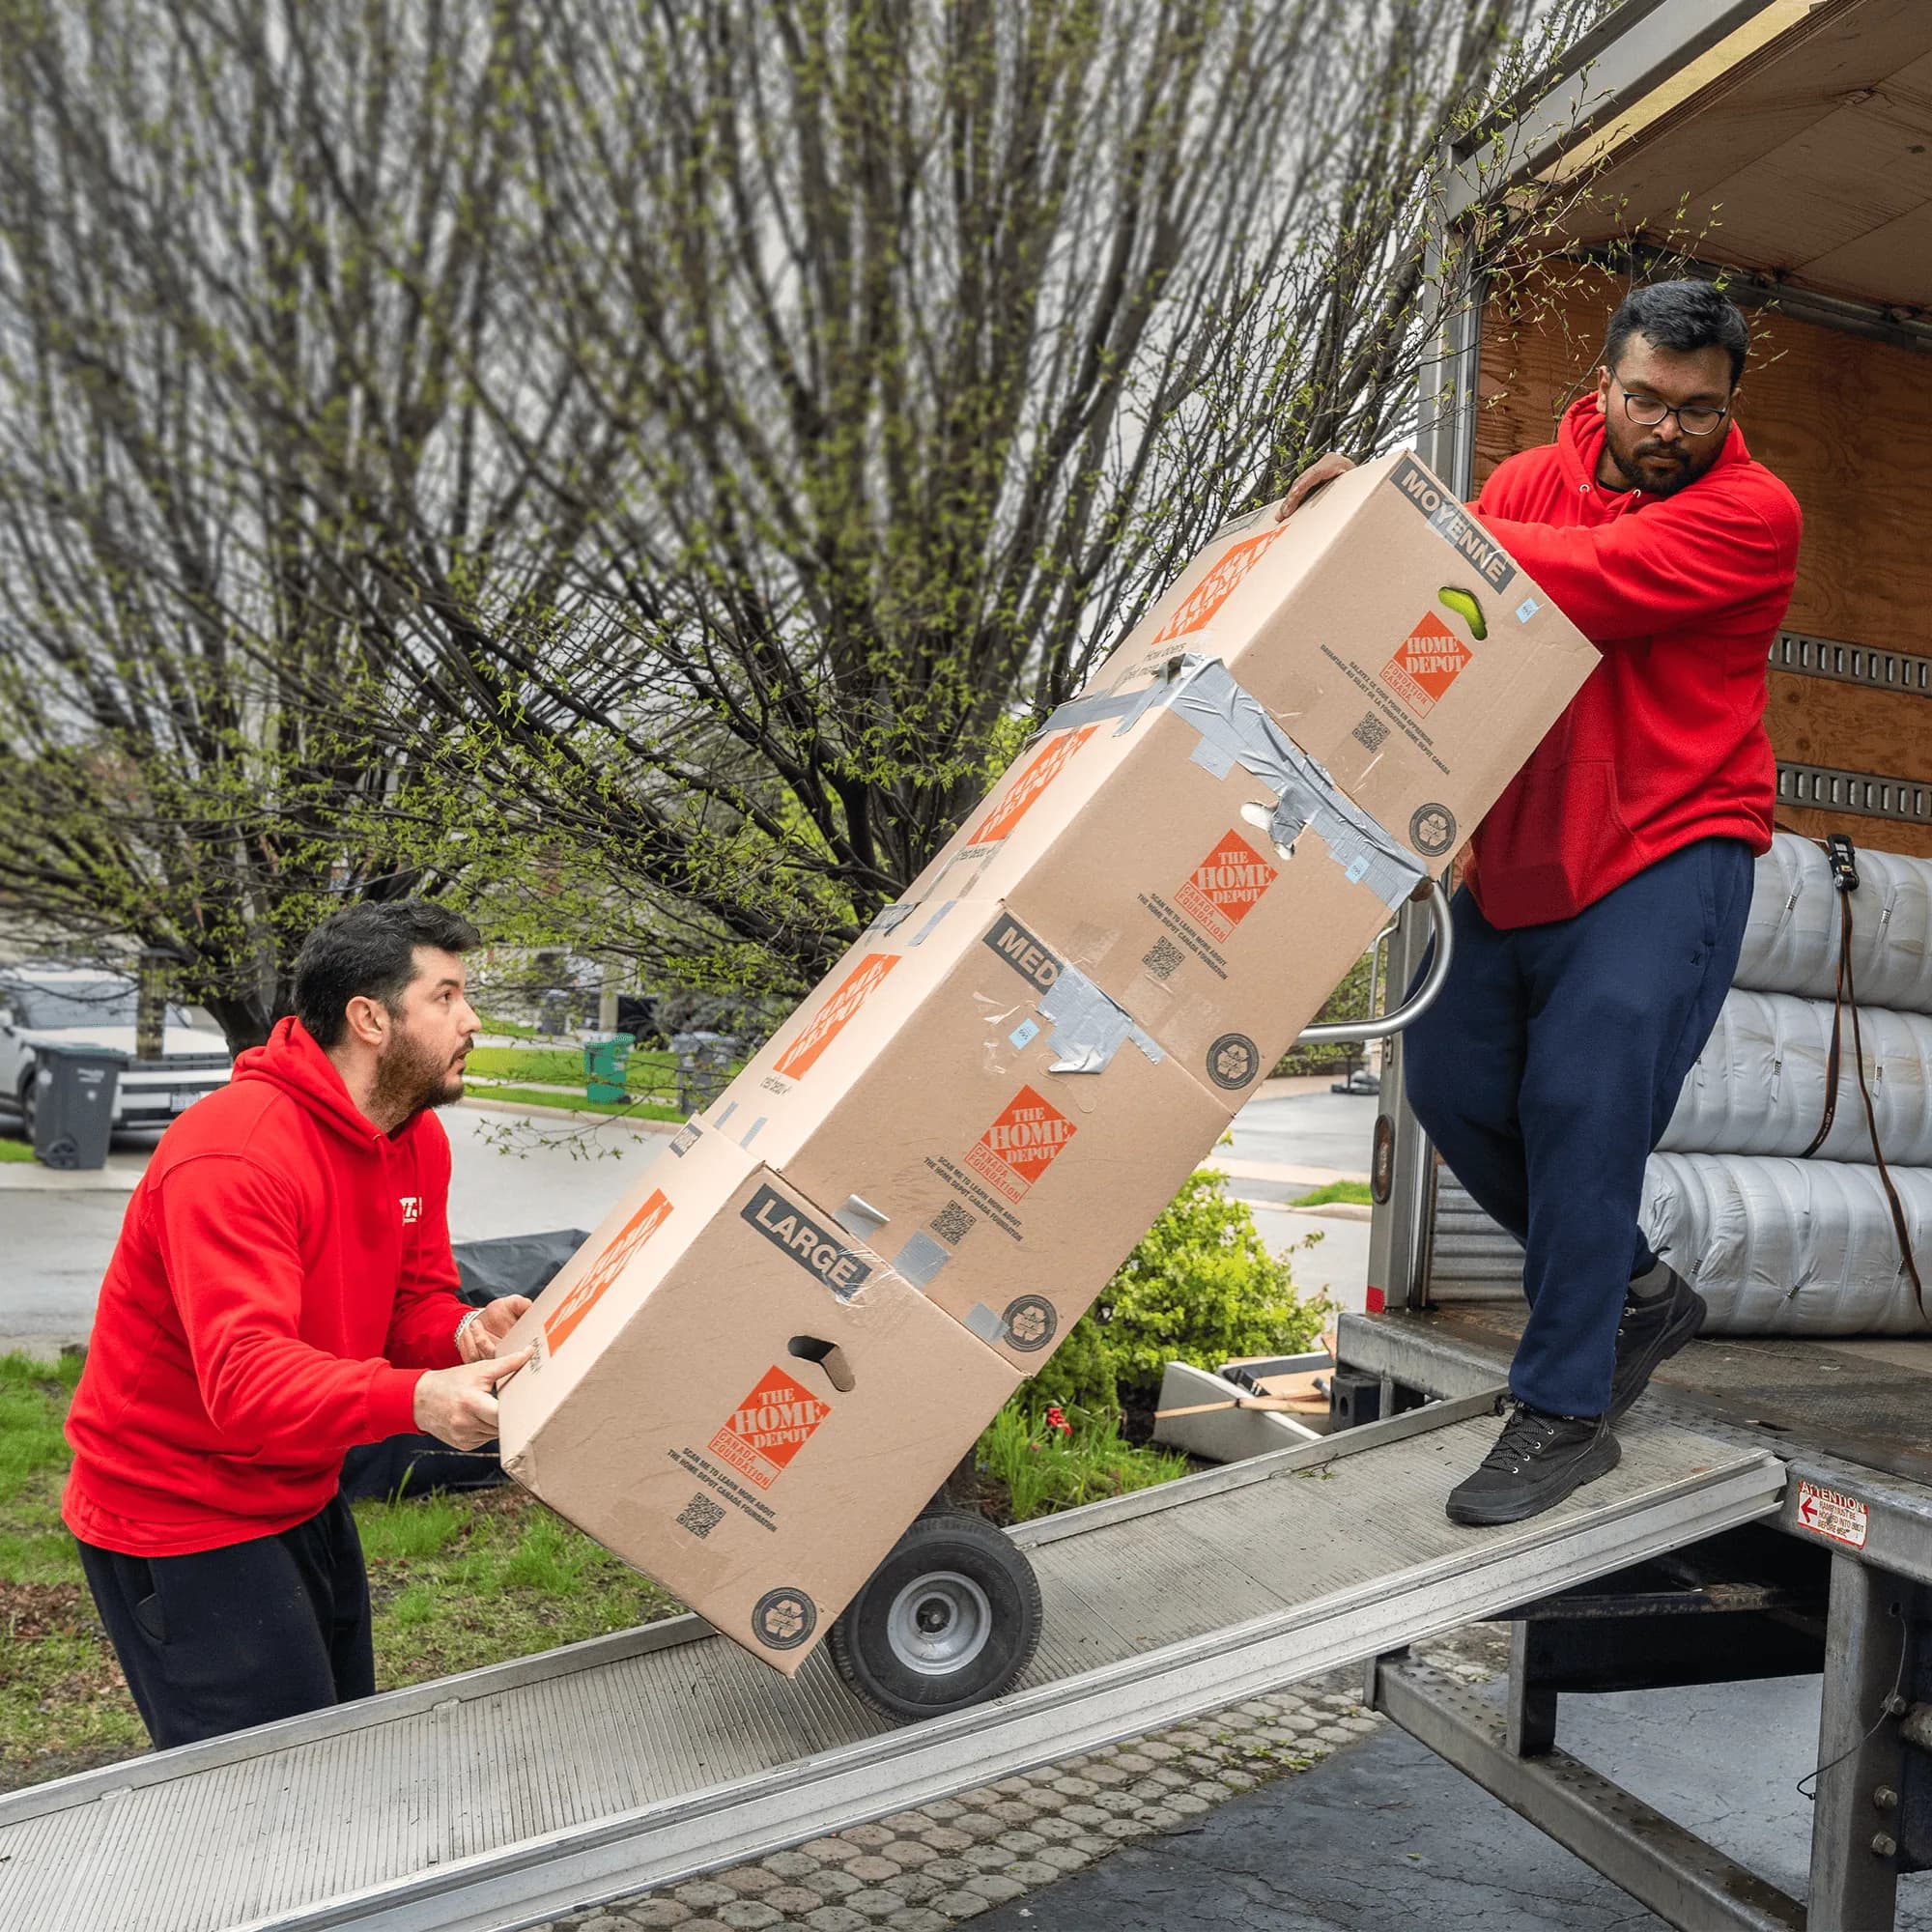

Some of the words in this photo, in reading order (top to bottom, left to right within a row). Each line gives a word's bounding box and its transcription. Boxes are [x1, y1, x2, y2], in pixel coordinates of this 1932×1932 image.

[1402, 469, 1506, 582] MOYENNE
[1407, 636, 1459, 654] HOME
[1406, 656, 1464, 673] DEPOT
[1383, 671, 1411, 702] CANADA
[1388, 664, 1429, 705] FONDATION
[1218, 851, 1248, 865] THE
[1197, 864, 1271, 891] HOME
[1183, 886, 1214, 918] CANADA
[1212, 889, 1260, 904] DEPOT
[1137, 894, 1149, 905] THE
[1161, 916, 1179, 934] DEPOT
[1177, 931, 1198, 952] CANADA
[1179, 894, 1226, 939] FOUNDATION
[1179, 920, 1196, 937] LEARN
[997, 926, 1059, 986] MED
[1012, 1107, 1045, 1122] THE
[989, 1120, 1069, 1150] HOME
[975, 1146, 1008, 1177] CANADA
[1006, 1146, 1058, 1163] DEPOT
[923, 1157, 936, 1168] THE
[951, 1179, 969, 1197] DEPOT
[968, 1194, 991, 1214] CANADA
[969, 1182, 988, 1200] LEARN
[970, 1154, 1020, 1201] FOUNDATION
[755, 1199, 859, 1287] LARGE
[758, 1388, 795, 1406] THE
[735, 1399, 823, 1435] HOME
[719, 1432, 756, 1463] CANADA
[753, 1427, 810, 1449] DEPOT
[667, 1449, 680, 1461] THE
[696, 1471, 718, 1489] DEPOT
[717, 1485, 741, 1506] CANADA
[712, 1440, 770, 1486] FOUNDATION
[717, 1473, 738, 1491] LEARN
[1801, 1481, 1864, 1514] ATTENTION
